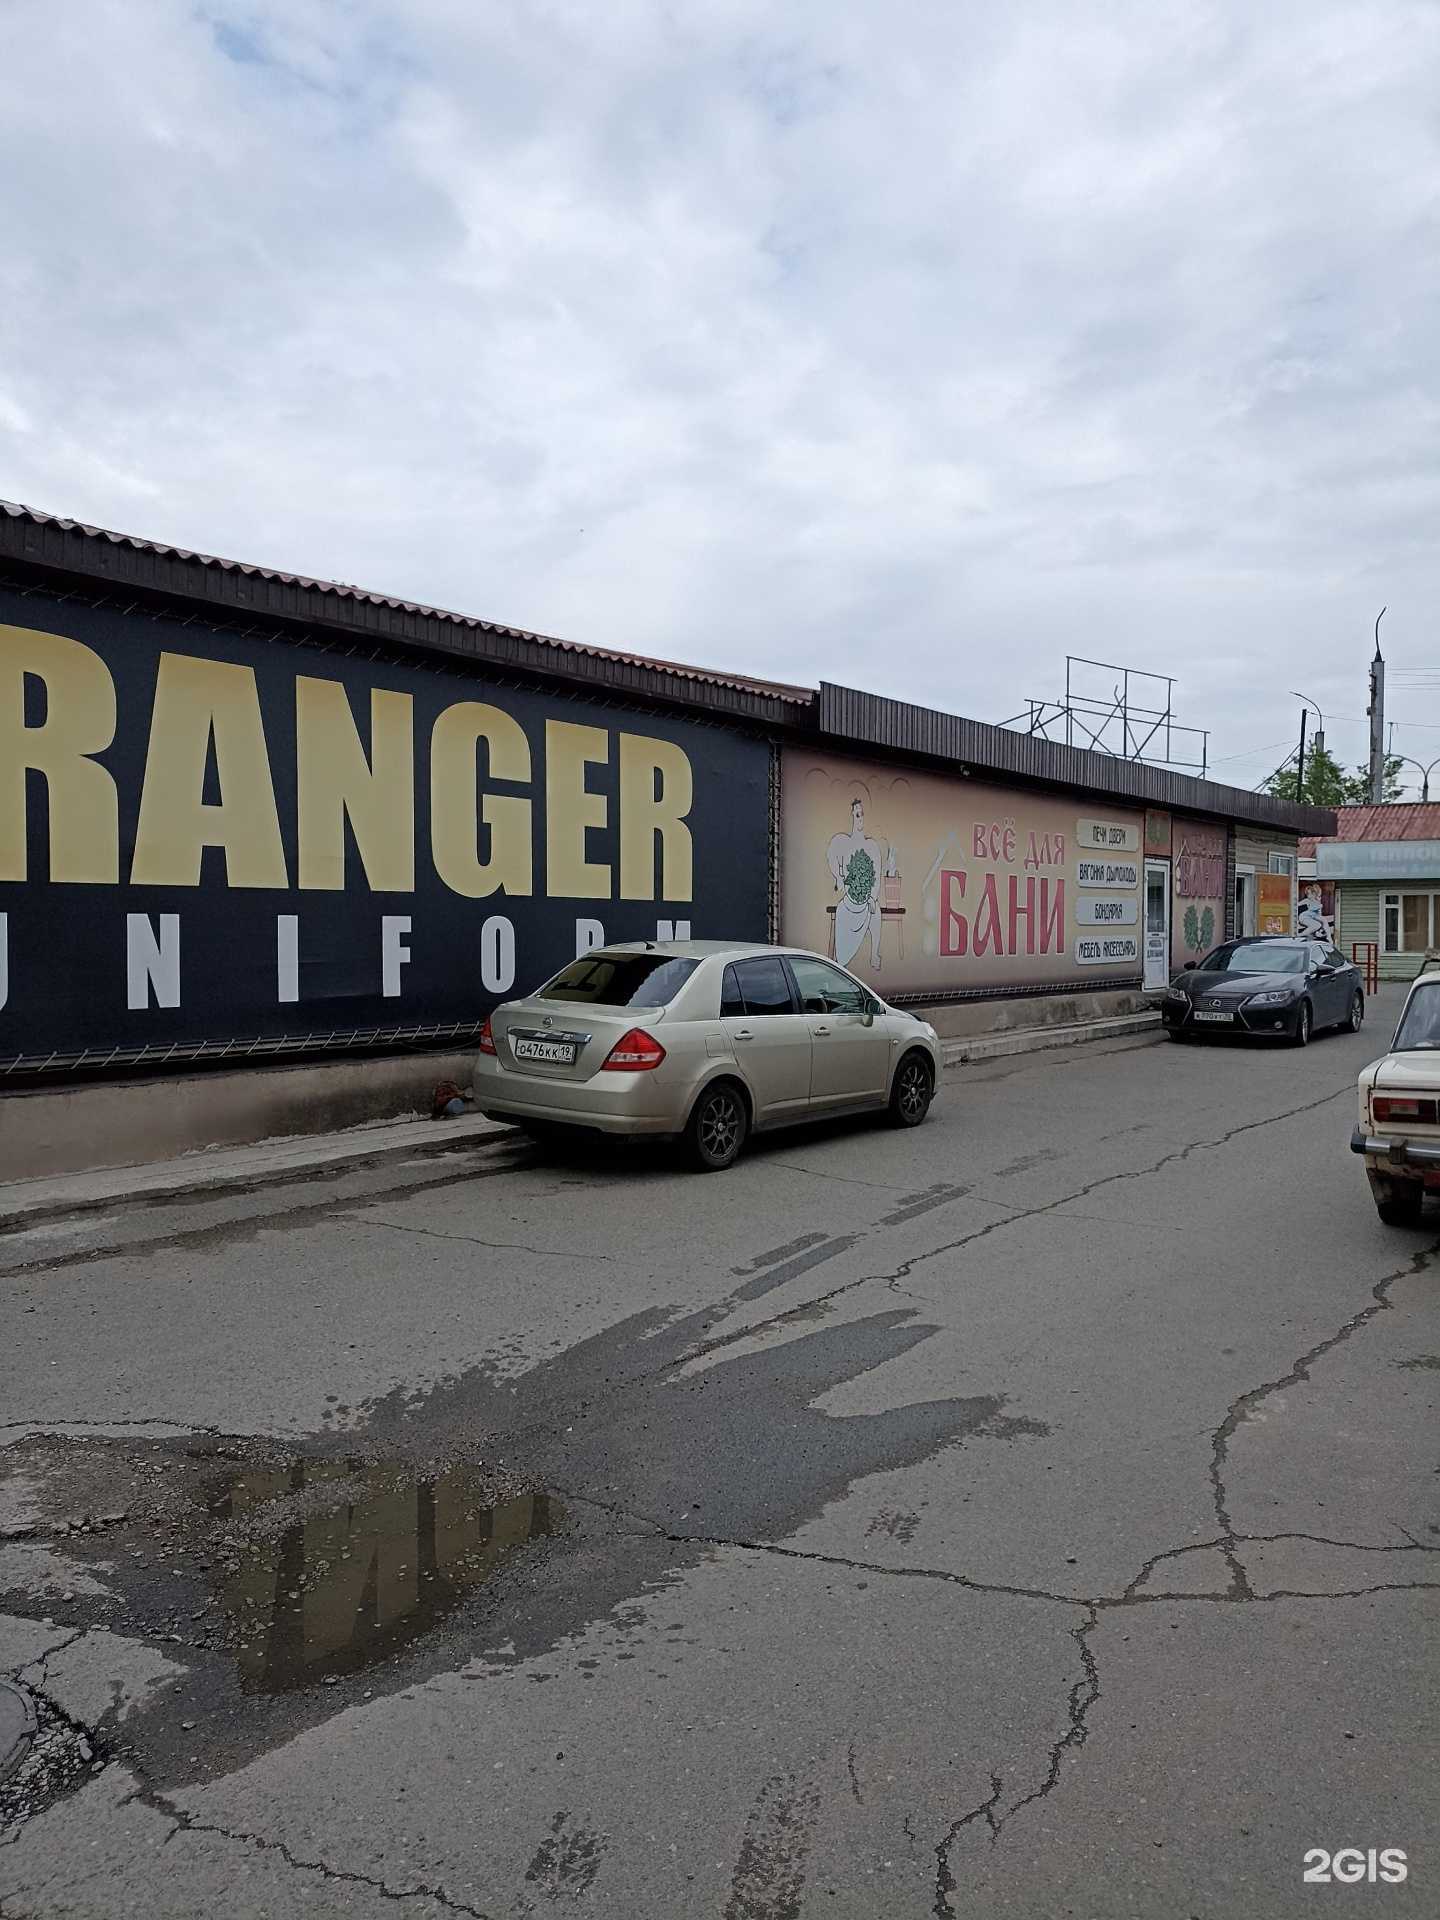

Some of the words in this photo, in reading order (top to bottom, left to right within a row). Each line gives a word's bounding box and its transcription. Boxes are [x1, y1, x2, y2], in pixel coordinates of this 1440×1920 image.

[0, 624, 693, 902] RANGER
[974, 817, 1016, 864] ВСЁ
[1024, 831, 1066, 870] ДЛЯ
[1079, 863, 1105, 882] ВАГОНКА
[940, 869, 1066, 957] БАНИ
[1078, 941, 1101, 959] МЕБЕЛЬ
